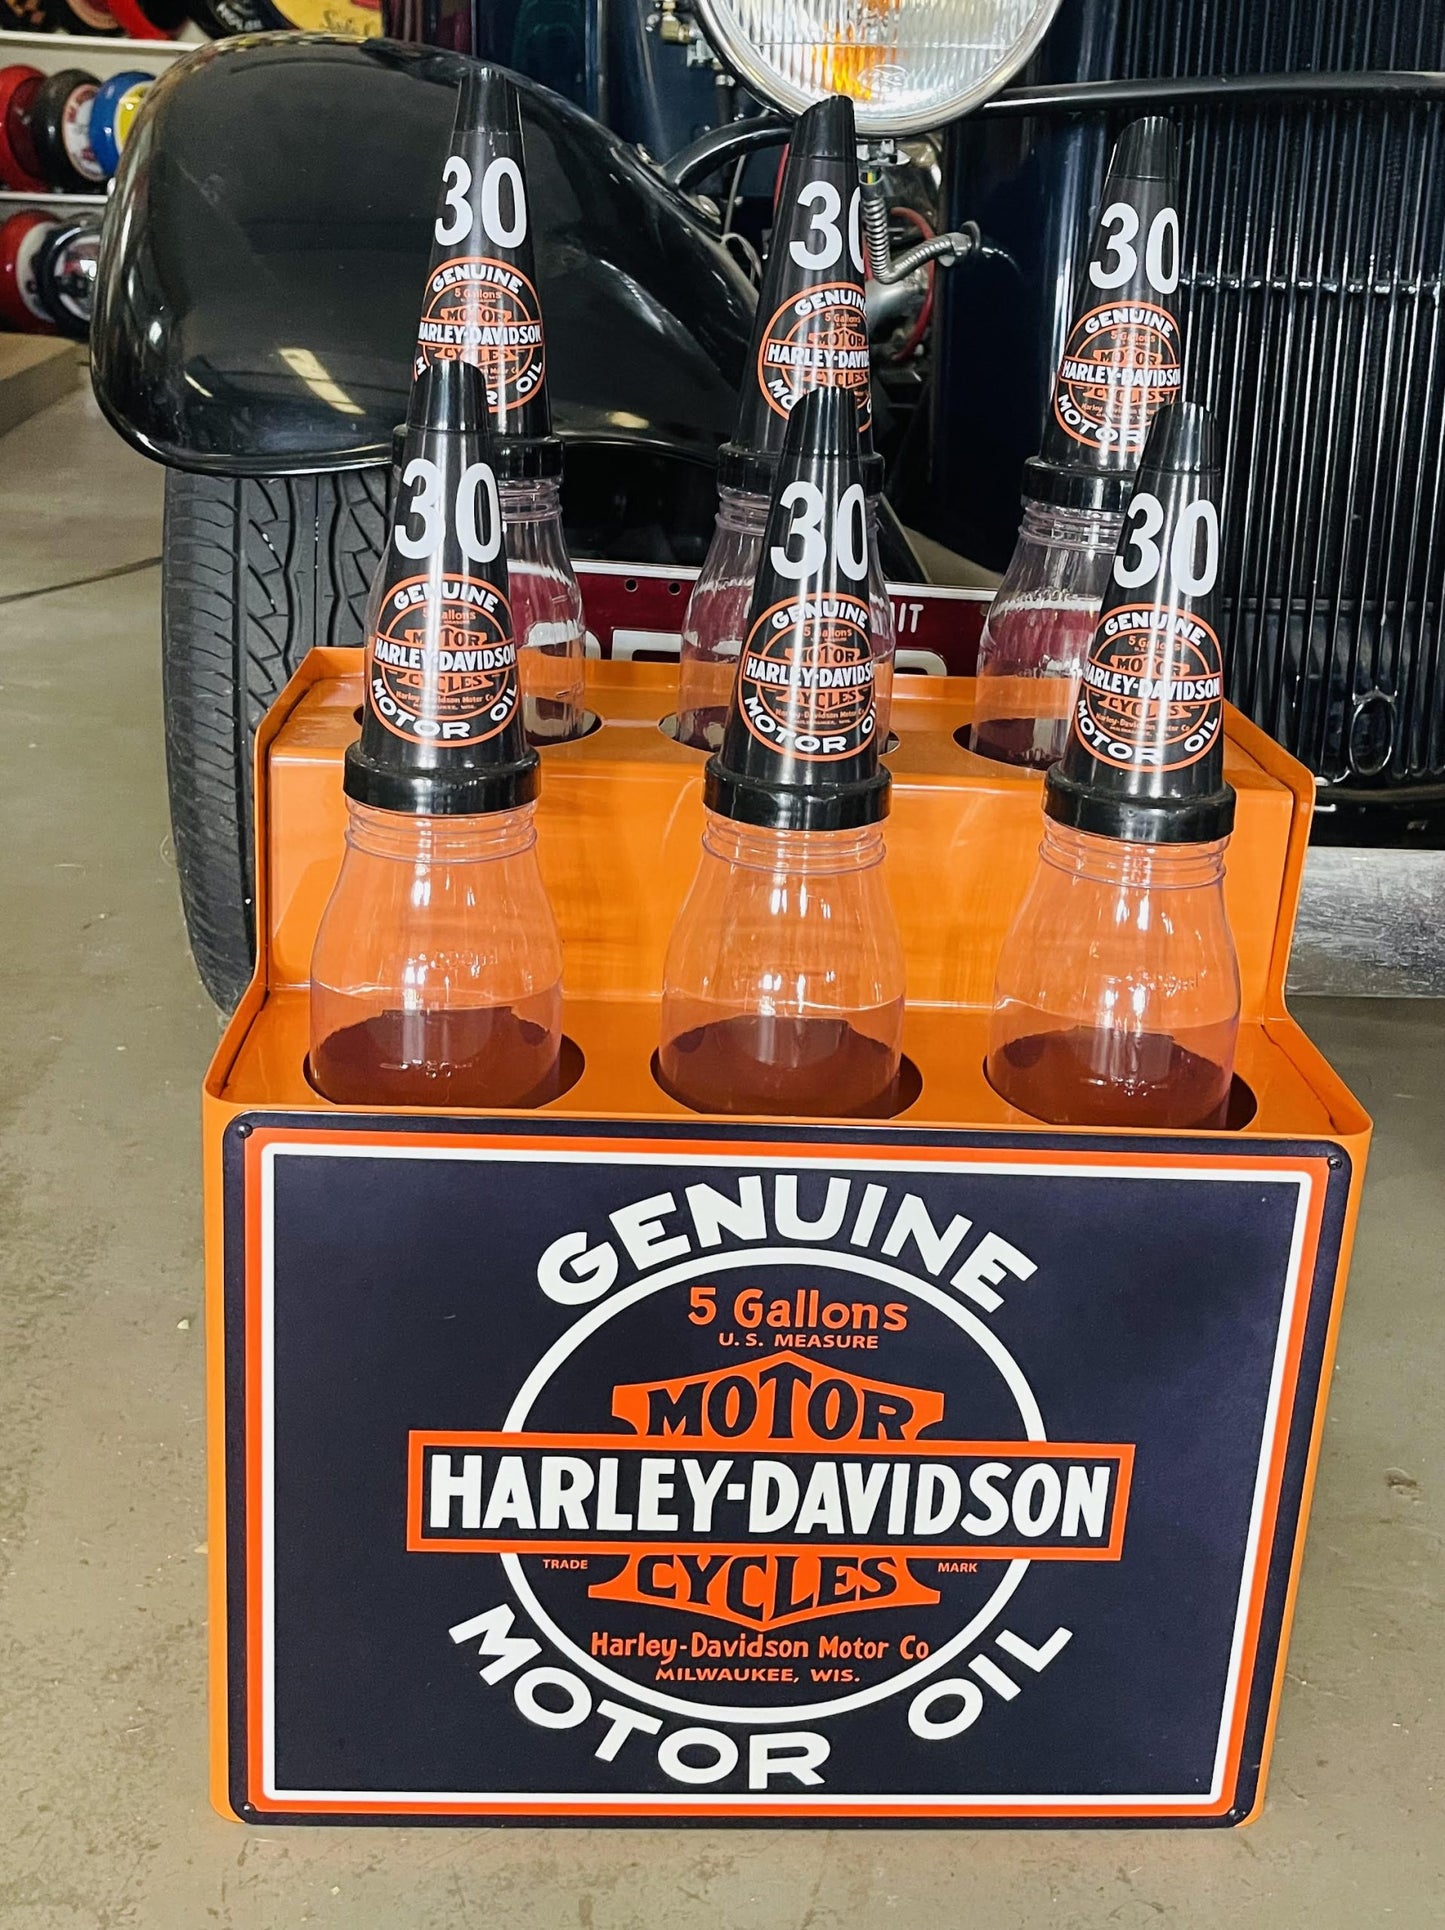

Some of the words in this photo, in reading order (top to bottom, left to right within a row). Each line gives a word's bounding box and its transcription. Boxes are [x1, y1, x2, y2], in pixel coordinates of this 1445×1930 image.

[435, 156, 527, 248] 30
[1089, 202, 1179, 294] 30
[432, 264, 523, 294] GENUINE
[794, 289, 867, 317] GENUIN
[1085, 308, 1174, 338] GENUINE
[516, 362, 542, 393] OIL
[395, 458, 501, 563] 30
[770, 481, 868, 581] 30
[1113, 492, 1219, 597] 30
[394, 581, 499, 613] GENUINE
[771, 601, 868, 630] GENUINE
[1104, 611, 1206, 646] GENUINE
[413, 630, 480, 647] MTOR
[794, 646, 855, 664] OTOR
[409, 673, 483, 693] CCLES
[797, 690, 857, 709] YCLES
[372, 678, 471, 739] MOTOR
[489, 684, 518, 722] OIL
[744, 696, 847, 753] MOTOR
[1078, 699, 1161, 765] MOTOR
[1184, 717, 1218, 752] OIL
[537, 1174, 1038, 1313] GENUINE
[688, 1286, 717, 1325] 5
[734, 1289, 909, 1331] Gallons
[774, 1334, 879, 1349] MEASURE
[647, 1362, 914, 1441] MOTOR
[429, 1453, 1111, 1538] HARLEY-DAVIDSON
[543, 1559, 588, 1570] TRADE
[938, 1562, 978, 1573] MARK
[637, 1554, 898, 1622] CYCLES
[591, 1632, 809, 1665] Harley-Davidson
[819, 1634, 888, 1659] Motor
[900, 1635, 929, 1660] Co
[655, 1667, 800, 1683] MILWAUKEE,
[811, 1668, 860, 1682] WIS.
[907, 1625, 1074, 1740] OIL
[448, 1603, 831, 1789] MOTOR
